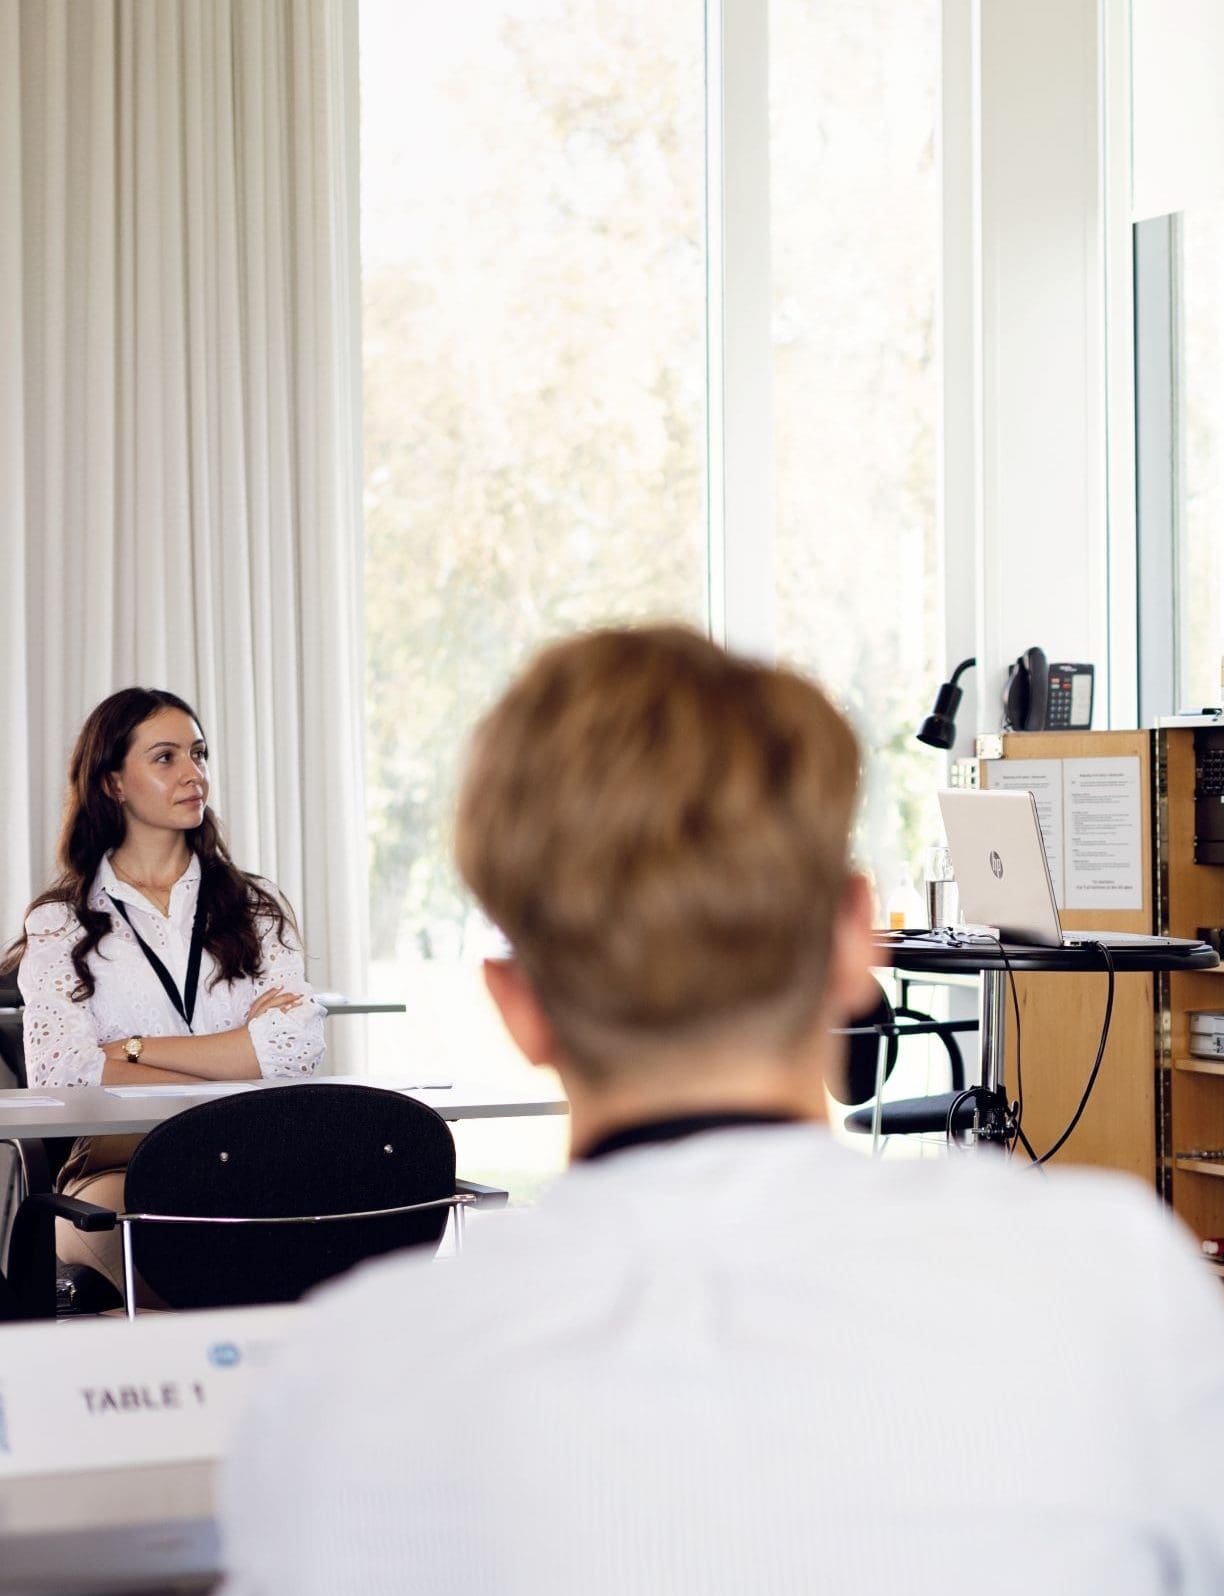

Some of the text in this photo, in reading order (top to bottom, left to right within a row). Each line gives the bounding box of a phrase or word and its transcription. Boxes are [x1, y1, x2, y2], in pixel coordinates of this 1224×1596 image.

[990, 850, 1003, 879] hp
[81, 1379, 205, 1415] TABLE 1
